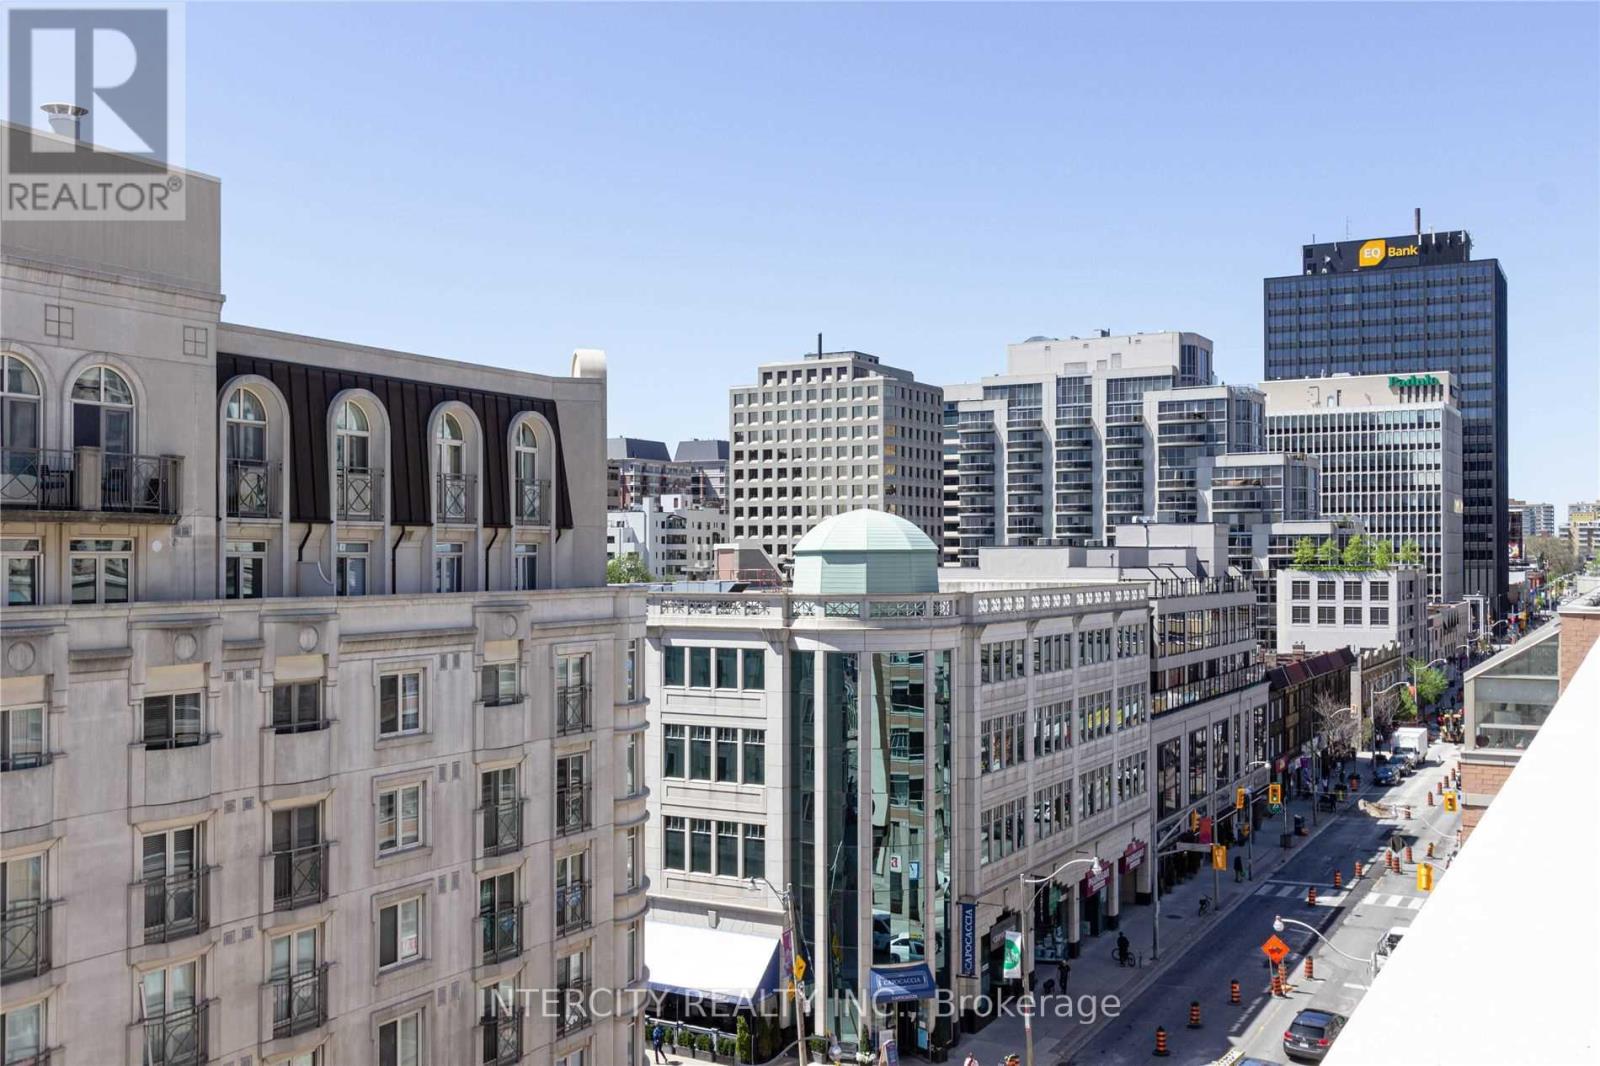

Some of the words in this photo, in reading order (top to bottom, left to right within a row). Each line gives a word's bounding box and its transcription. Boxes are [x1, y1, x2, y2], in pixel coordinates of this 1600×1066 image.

[1363, 247, 1381, 259] EQ
[1388, 244, 1418, 257] Bank
[964, 909, 974, 970] CAPOCACCIA
